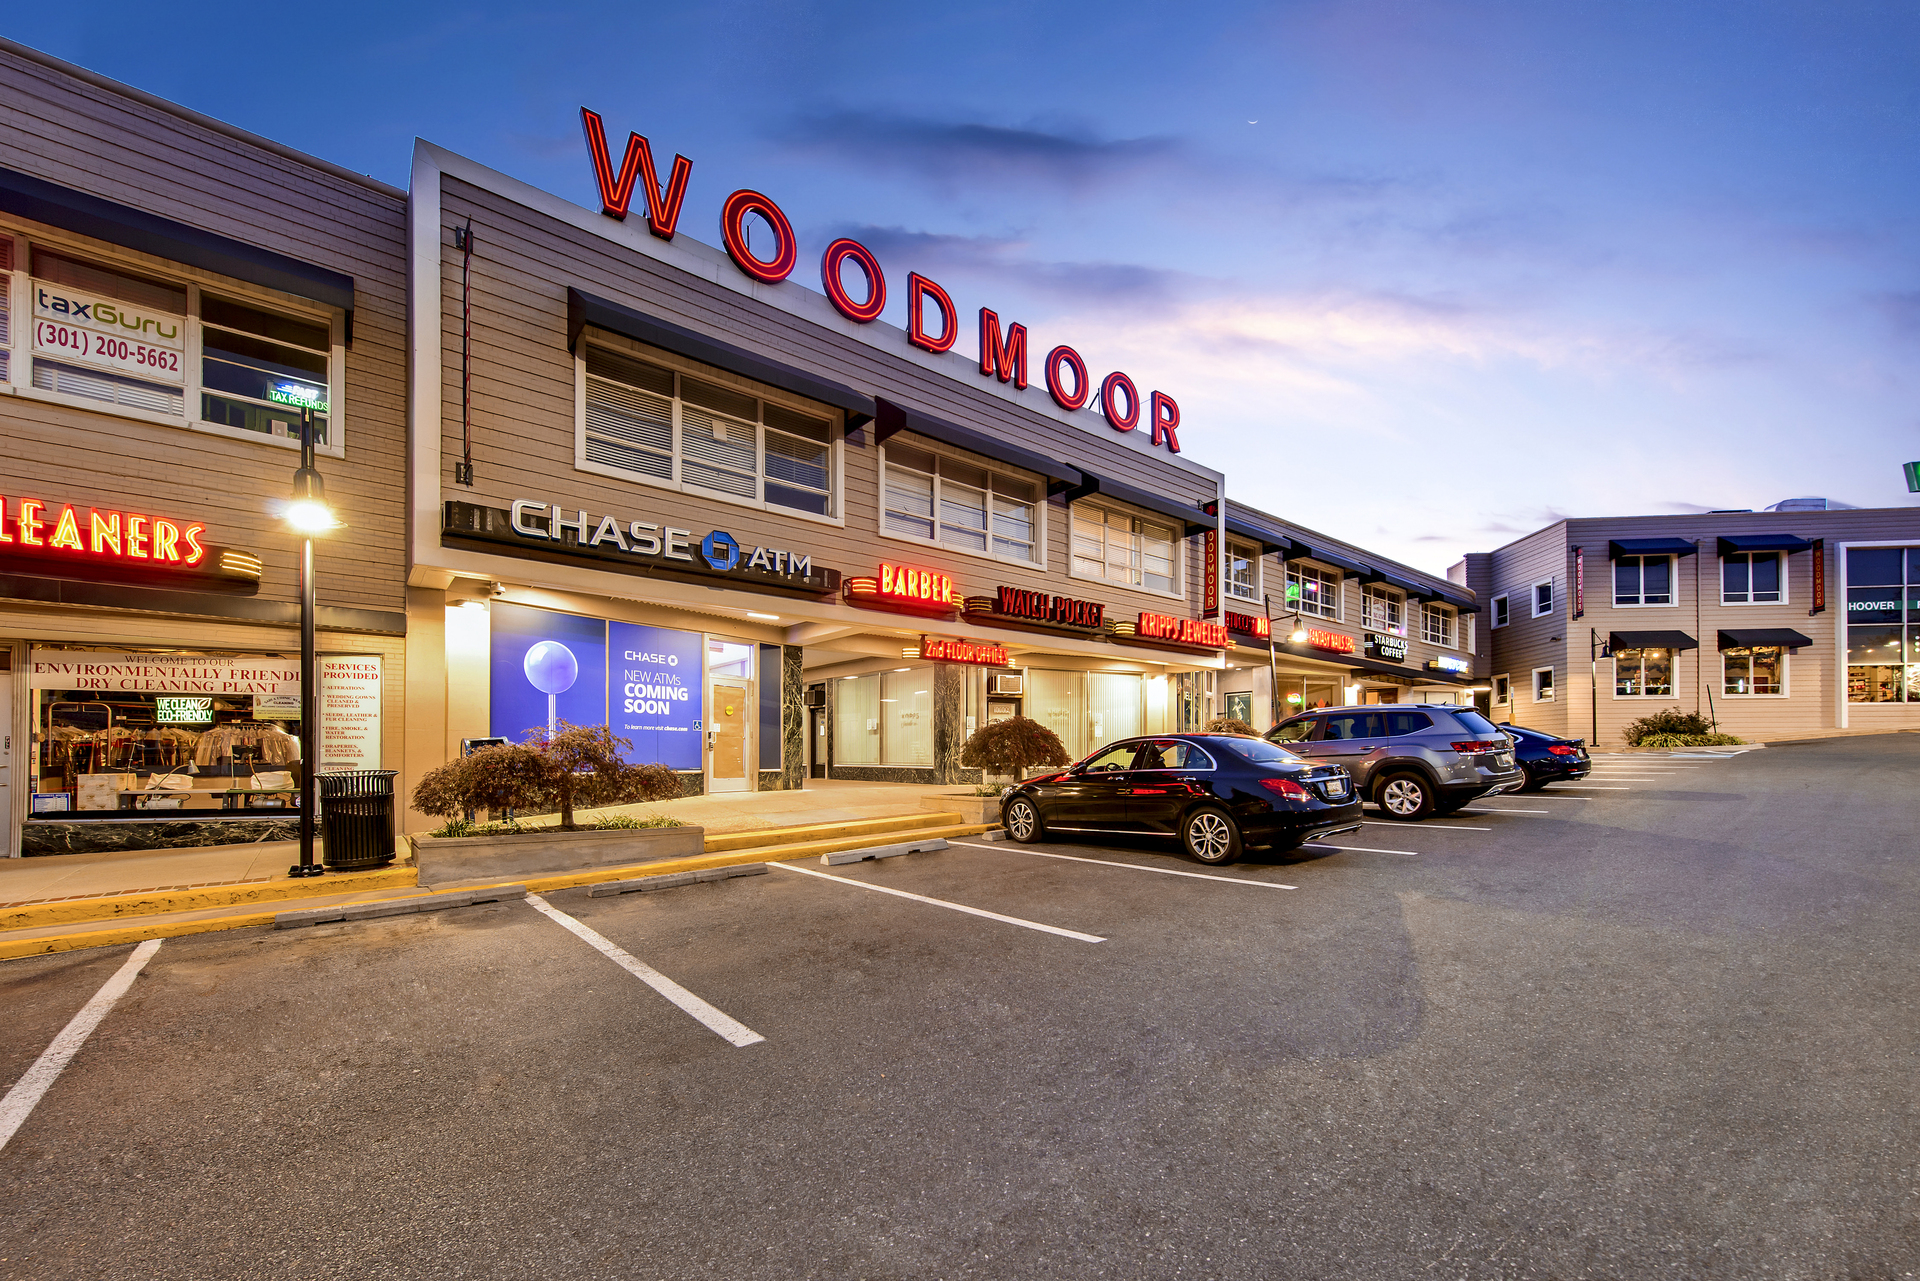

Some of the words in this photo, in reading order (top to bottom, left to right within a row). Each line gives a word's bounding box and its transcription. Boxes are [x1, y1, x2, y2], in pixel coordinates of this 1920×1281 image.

[579, 105, 1181, 453] WOODMOOR
[38, 288, 177, 339] taxGuru
[37, 322, 89, 355] (301)
[96, 336, 178, 372] 200-5662
[270, 390, 288, 403] TAX
[289, 394, 329, 411] REFUNDS
[511, 499, 693, 562] CHASE
[748, 546, 812, 578] ATM
[880, 563, 953, 604] BARBER
[997, 586, 1050, 619] WATCH
[1053, 596, 1105, 627] POCKET
[1848, 601, 1895, 611] HOOVER
[1139, 612, 1179, 639] KRIPPS
[1181, 620, 1228, 647] JEWELERS
[1309, 628, 1330, 647] FANTASY
[1375, 634, 1408, 649] STARBUCKS
[624, 650, 666, 664] CHASE
[925, 640, 945, 658] 2nd
[946, 642, 974, 661] FLOOR
[976, 645, 1008, 664] OFFICES
[1381, 646, 1403, 659] COFFEE
[124, 655, 188, 666] WELCOME
[190, 658, 206, 666] TO
[209, 658, 234, 667] OUR
[325, 663, 377, 671] SERVICES
[34, 662, 222, 679] ENVIRONMENTALLY
[323, 671, 379, 680] PROVIDED
[624, 669, 652, 683] NEW
[653, 672, 681, 686] ATMs
[76, 677, 112, 689] DRY
[120, 679, 214, 692] CLEANING
[223, 682, 279, 693] PLANT
[624, 682, 689, 701] COMING
[156, 698, 170, 710] WE
[171, 699, 198, 711] CLEAN
[623, 698, 670, 715] SOON
[157, 710, 214, 721] ECO-FRIENDLY
